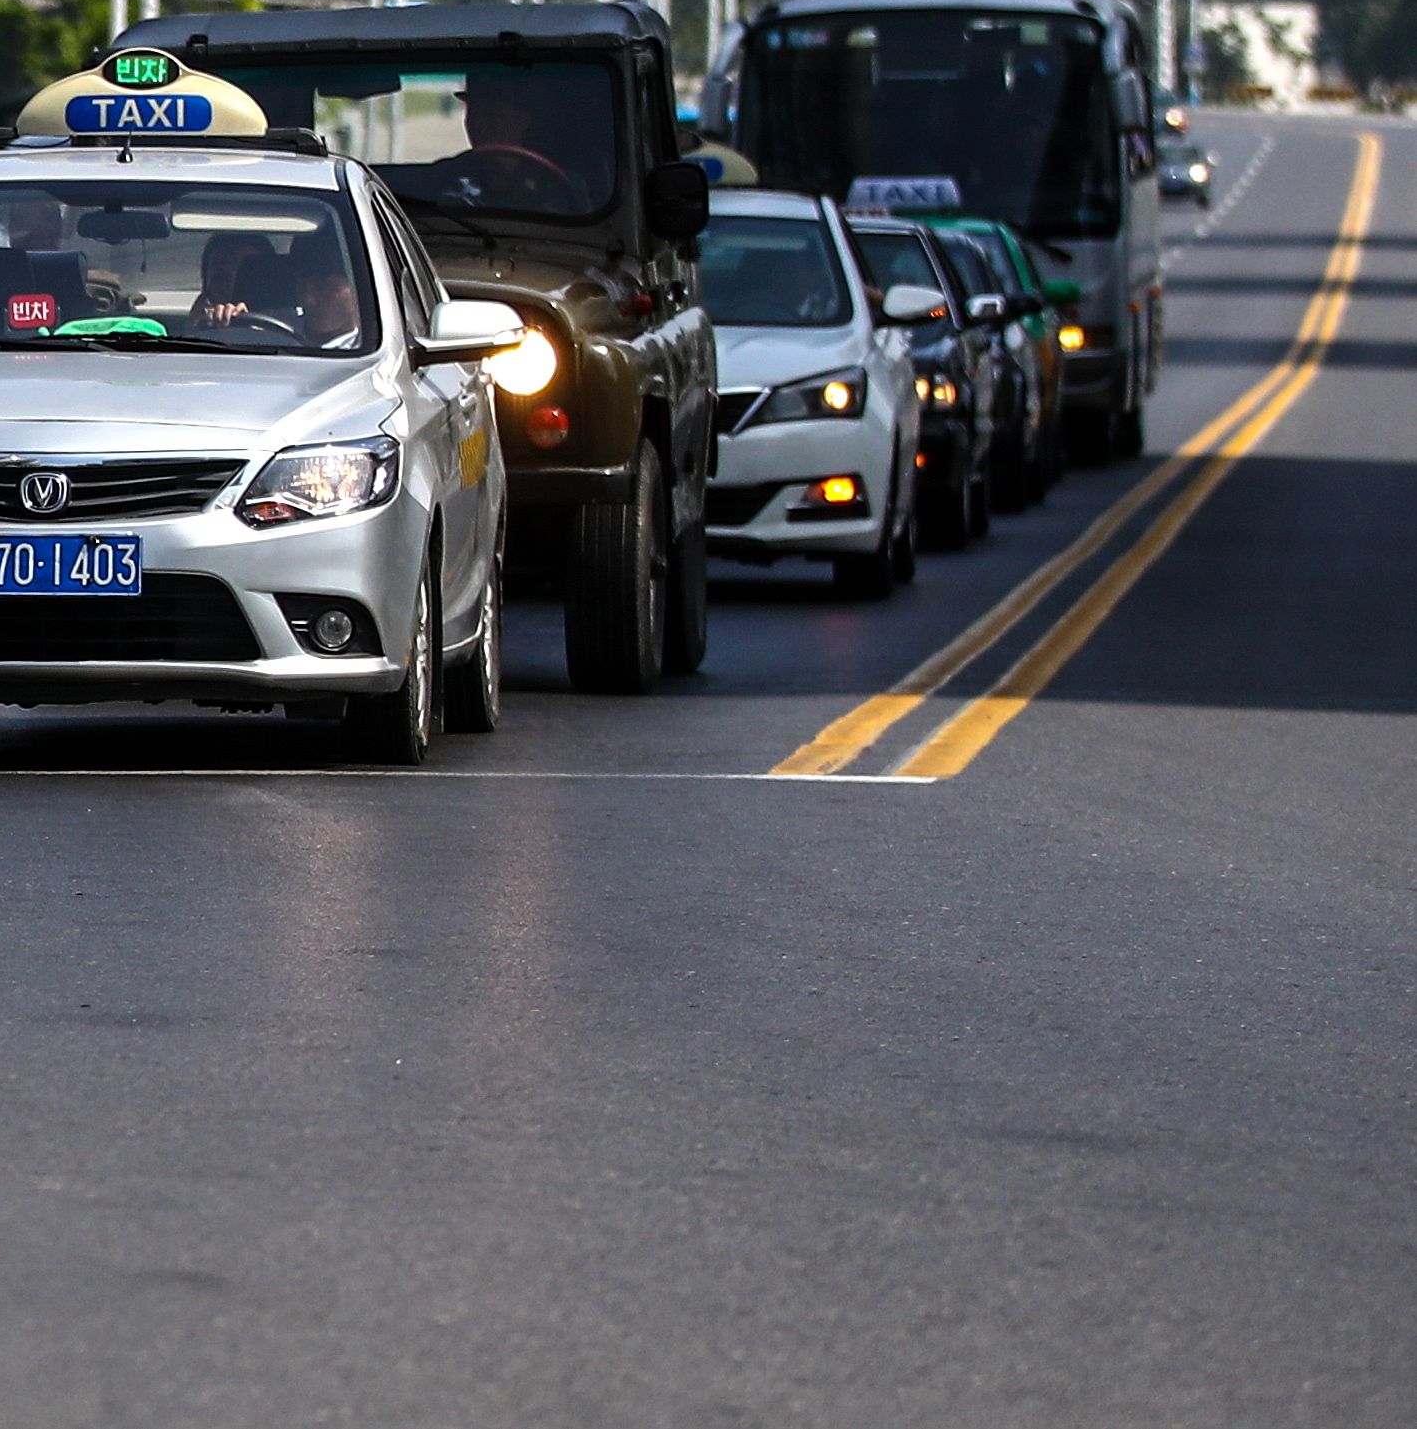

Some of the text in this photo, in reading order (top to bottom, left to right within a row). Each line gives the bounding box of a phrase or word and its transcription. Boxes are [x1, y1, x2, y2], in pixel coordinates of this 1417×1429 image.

[116, 58, 166, 83] 빈차
[91, 98, 185, 128] TAXI
[12, 301, 50, 321] 빈차
